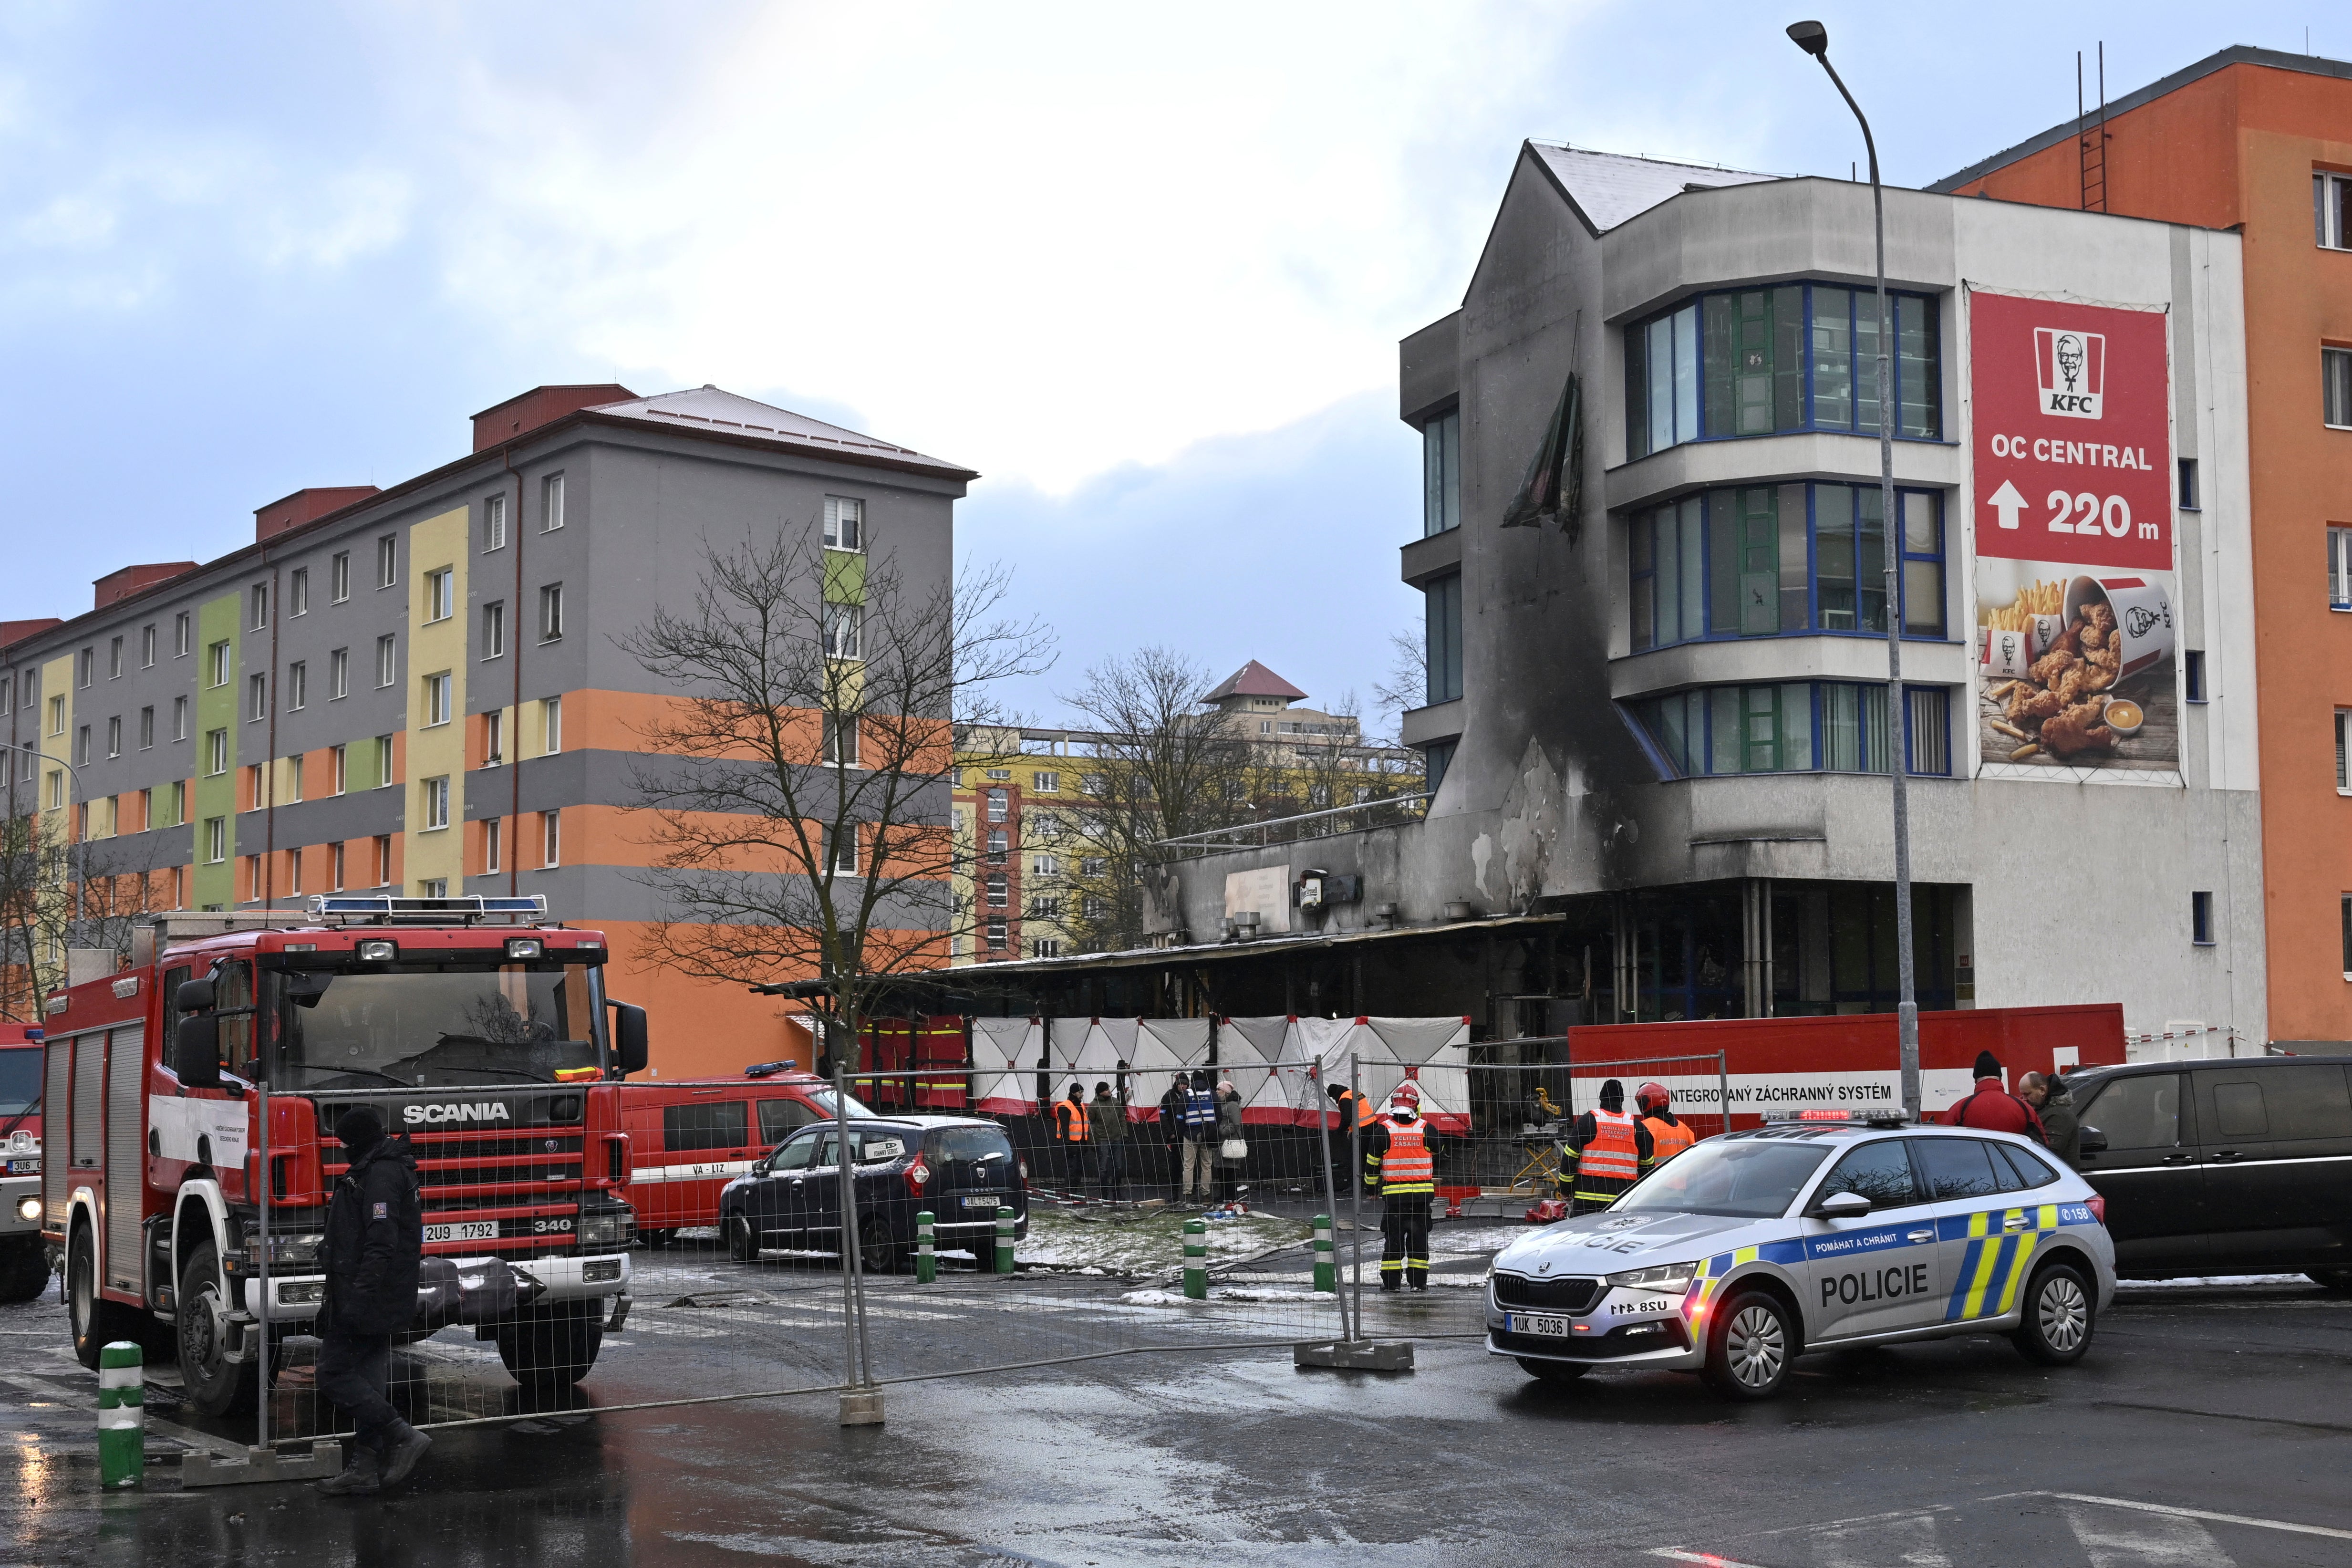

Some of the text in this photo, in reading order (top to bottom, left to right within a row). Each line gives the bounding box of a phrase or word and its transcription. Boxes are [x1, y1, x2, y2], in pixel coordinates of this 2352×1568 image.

[2050, 394, 2092, 413] KFC
[1991, 434, 2152, 470] OC CENTRAL
[2047, 490, 2159, 540] 220 m
[2160, 602, 2171, 629] KFC
[1667, 1082, 1891, 1102] NTEGROANÝ ZÁCHRANNÝ SYSTÉM
[403, 1102, 510, 1123] SCANIA
[15, 1161, 31, 1170] 3U6
[693, 1165, 703, 1174] VA
[966, 1197, 978, 1205] 3AL
[2071, 1207, 2089, 1219] 158
[426, 1223, 493, 1241] 2U9 1792
[534, 1219, 571, 1232] 340
[1815, 1239, 1854, 1253] POMÁHAT
[1864, 1233, 1896, 1246] CHRÁNIT
[1821, 1263, 1928, 1307] POLICIE
[1513, 1317, 1530, 1332] 1UK
[1537, 1319, 1563, 1334] 5036
